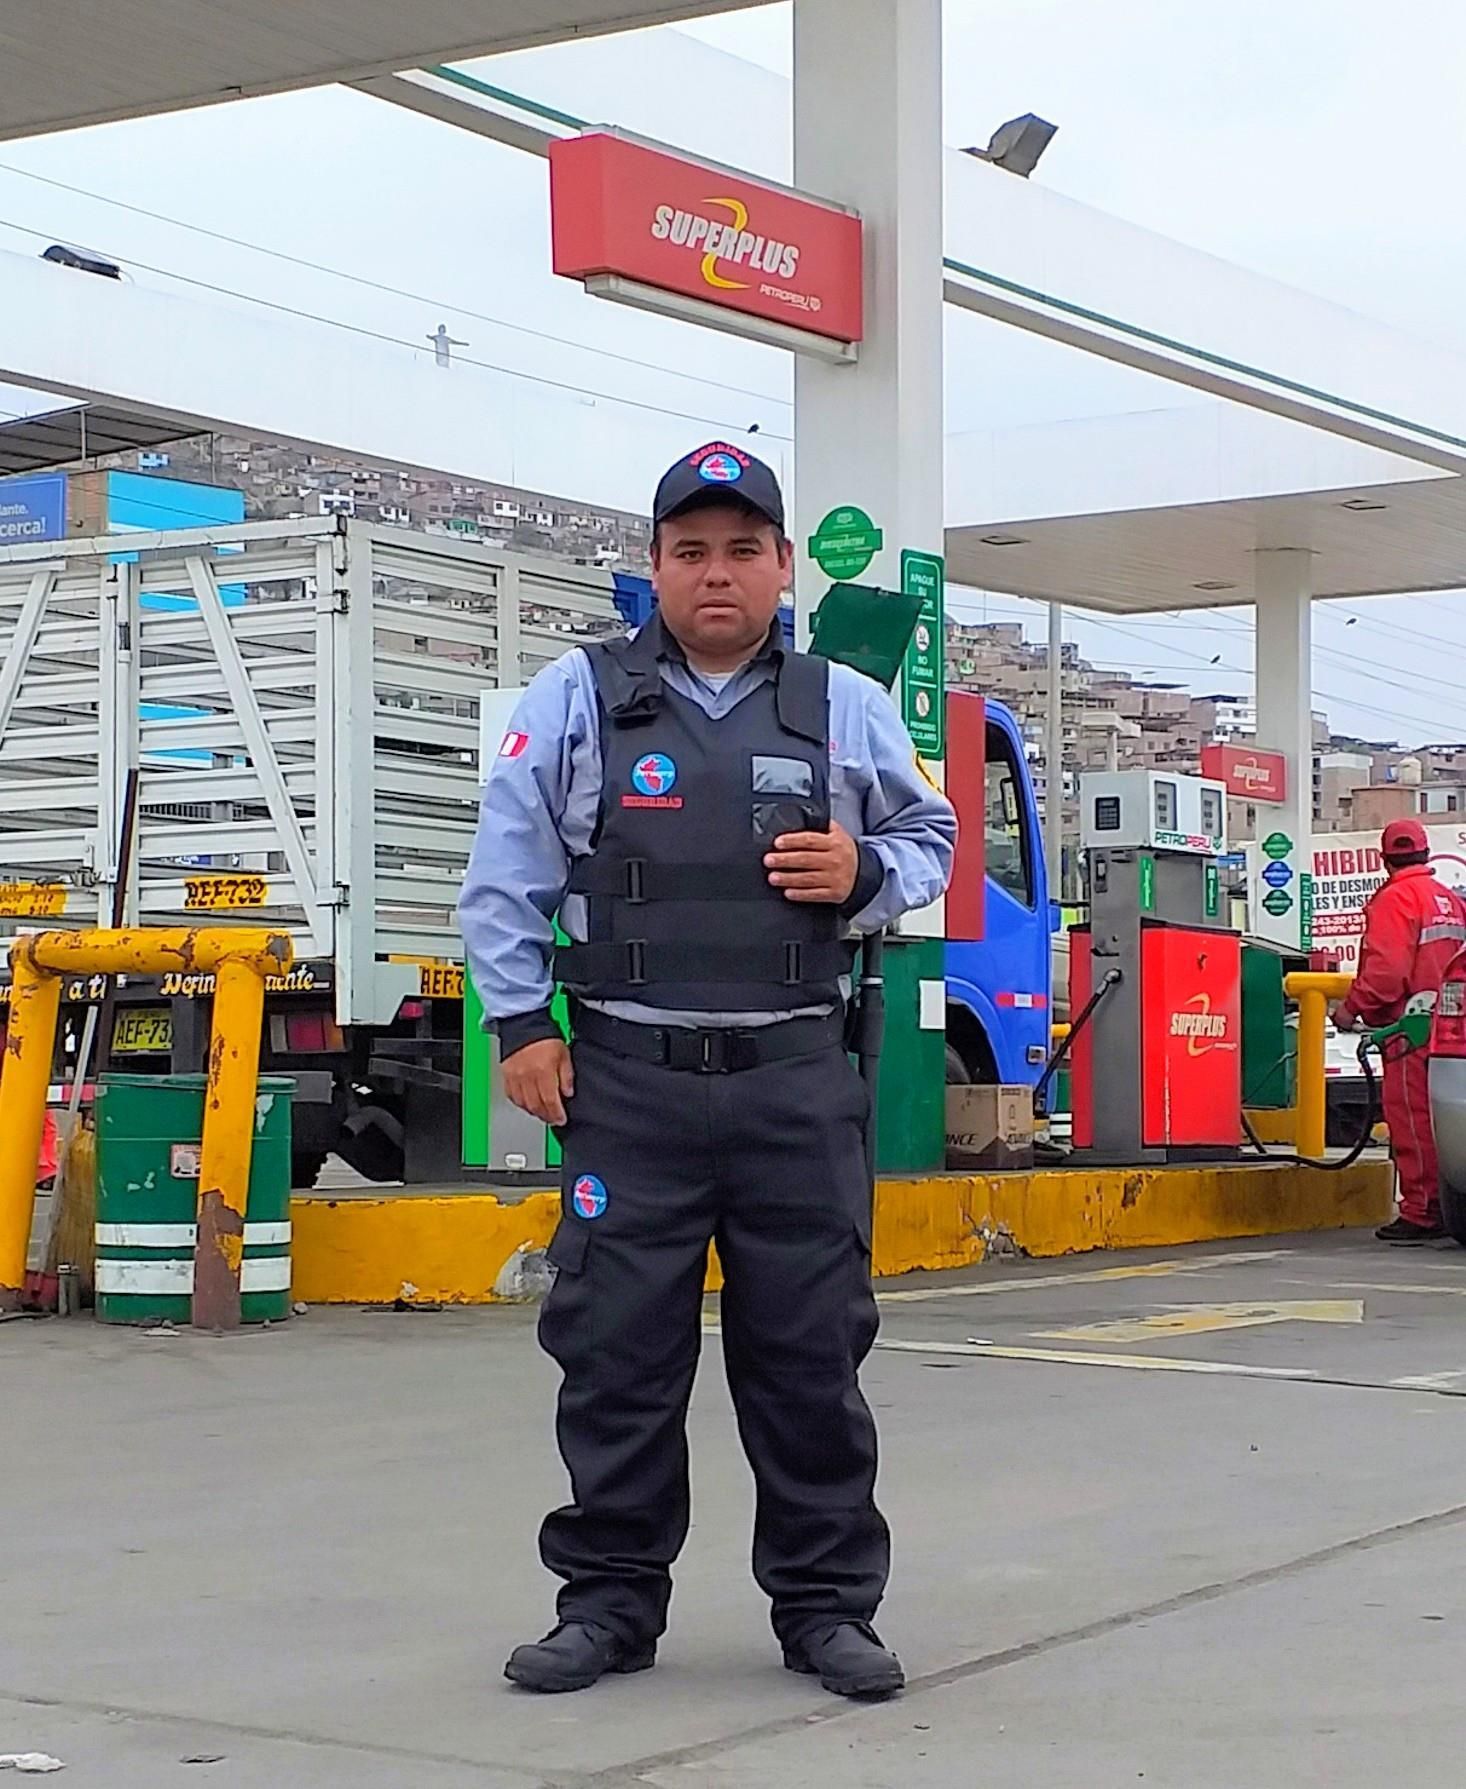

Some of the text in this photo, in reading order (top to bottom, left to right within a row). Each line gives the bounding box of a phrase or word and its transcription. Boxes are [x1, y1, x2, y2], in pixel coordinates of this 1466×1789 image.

[651, 204, 800, 279] SUPERPLUS
[0, 516, 46, 537] cerca!
[910, 573, 935, 587] APAGUE
[918, 655, 928, 665] NO
[1155, 831, 1212, 848] PETROPERU
[1313, 848, 1381, 876] HIBID
[1322, 881, 1336, 894] DE
[1339, 877, 1388, 893] DESMO
[1332, 895, 1339, 909] Y
[117, 1018, 172, 1046] AEF-73
[1170, 1012, 1226, 1037] SUPERPLUS
